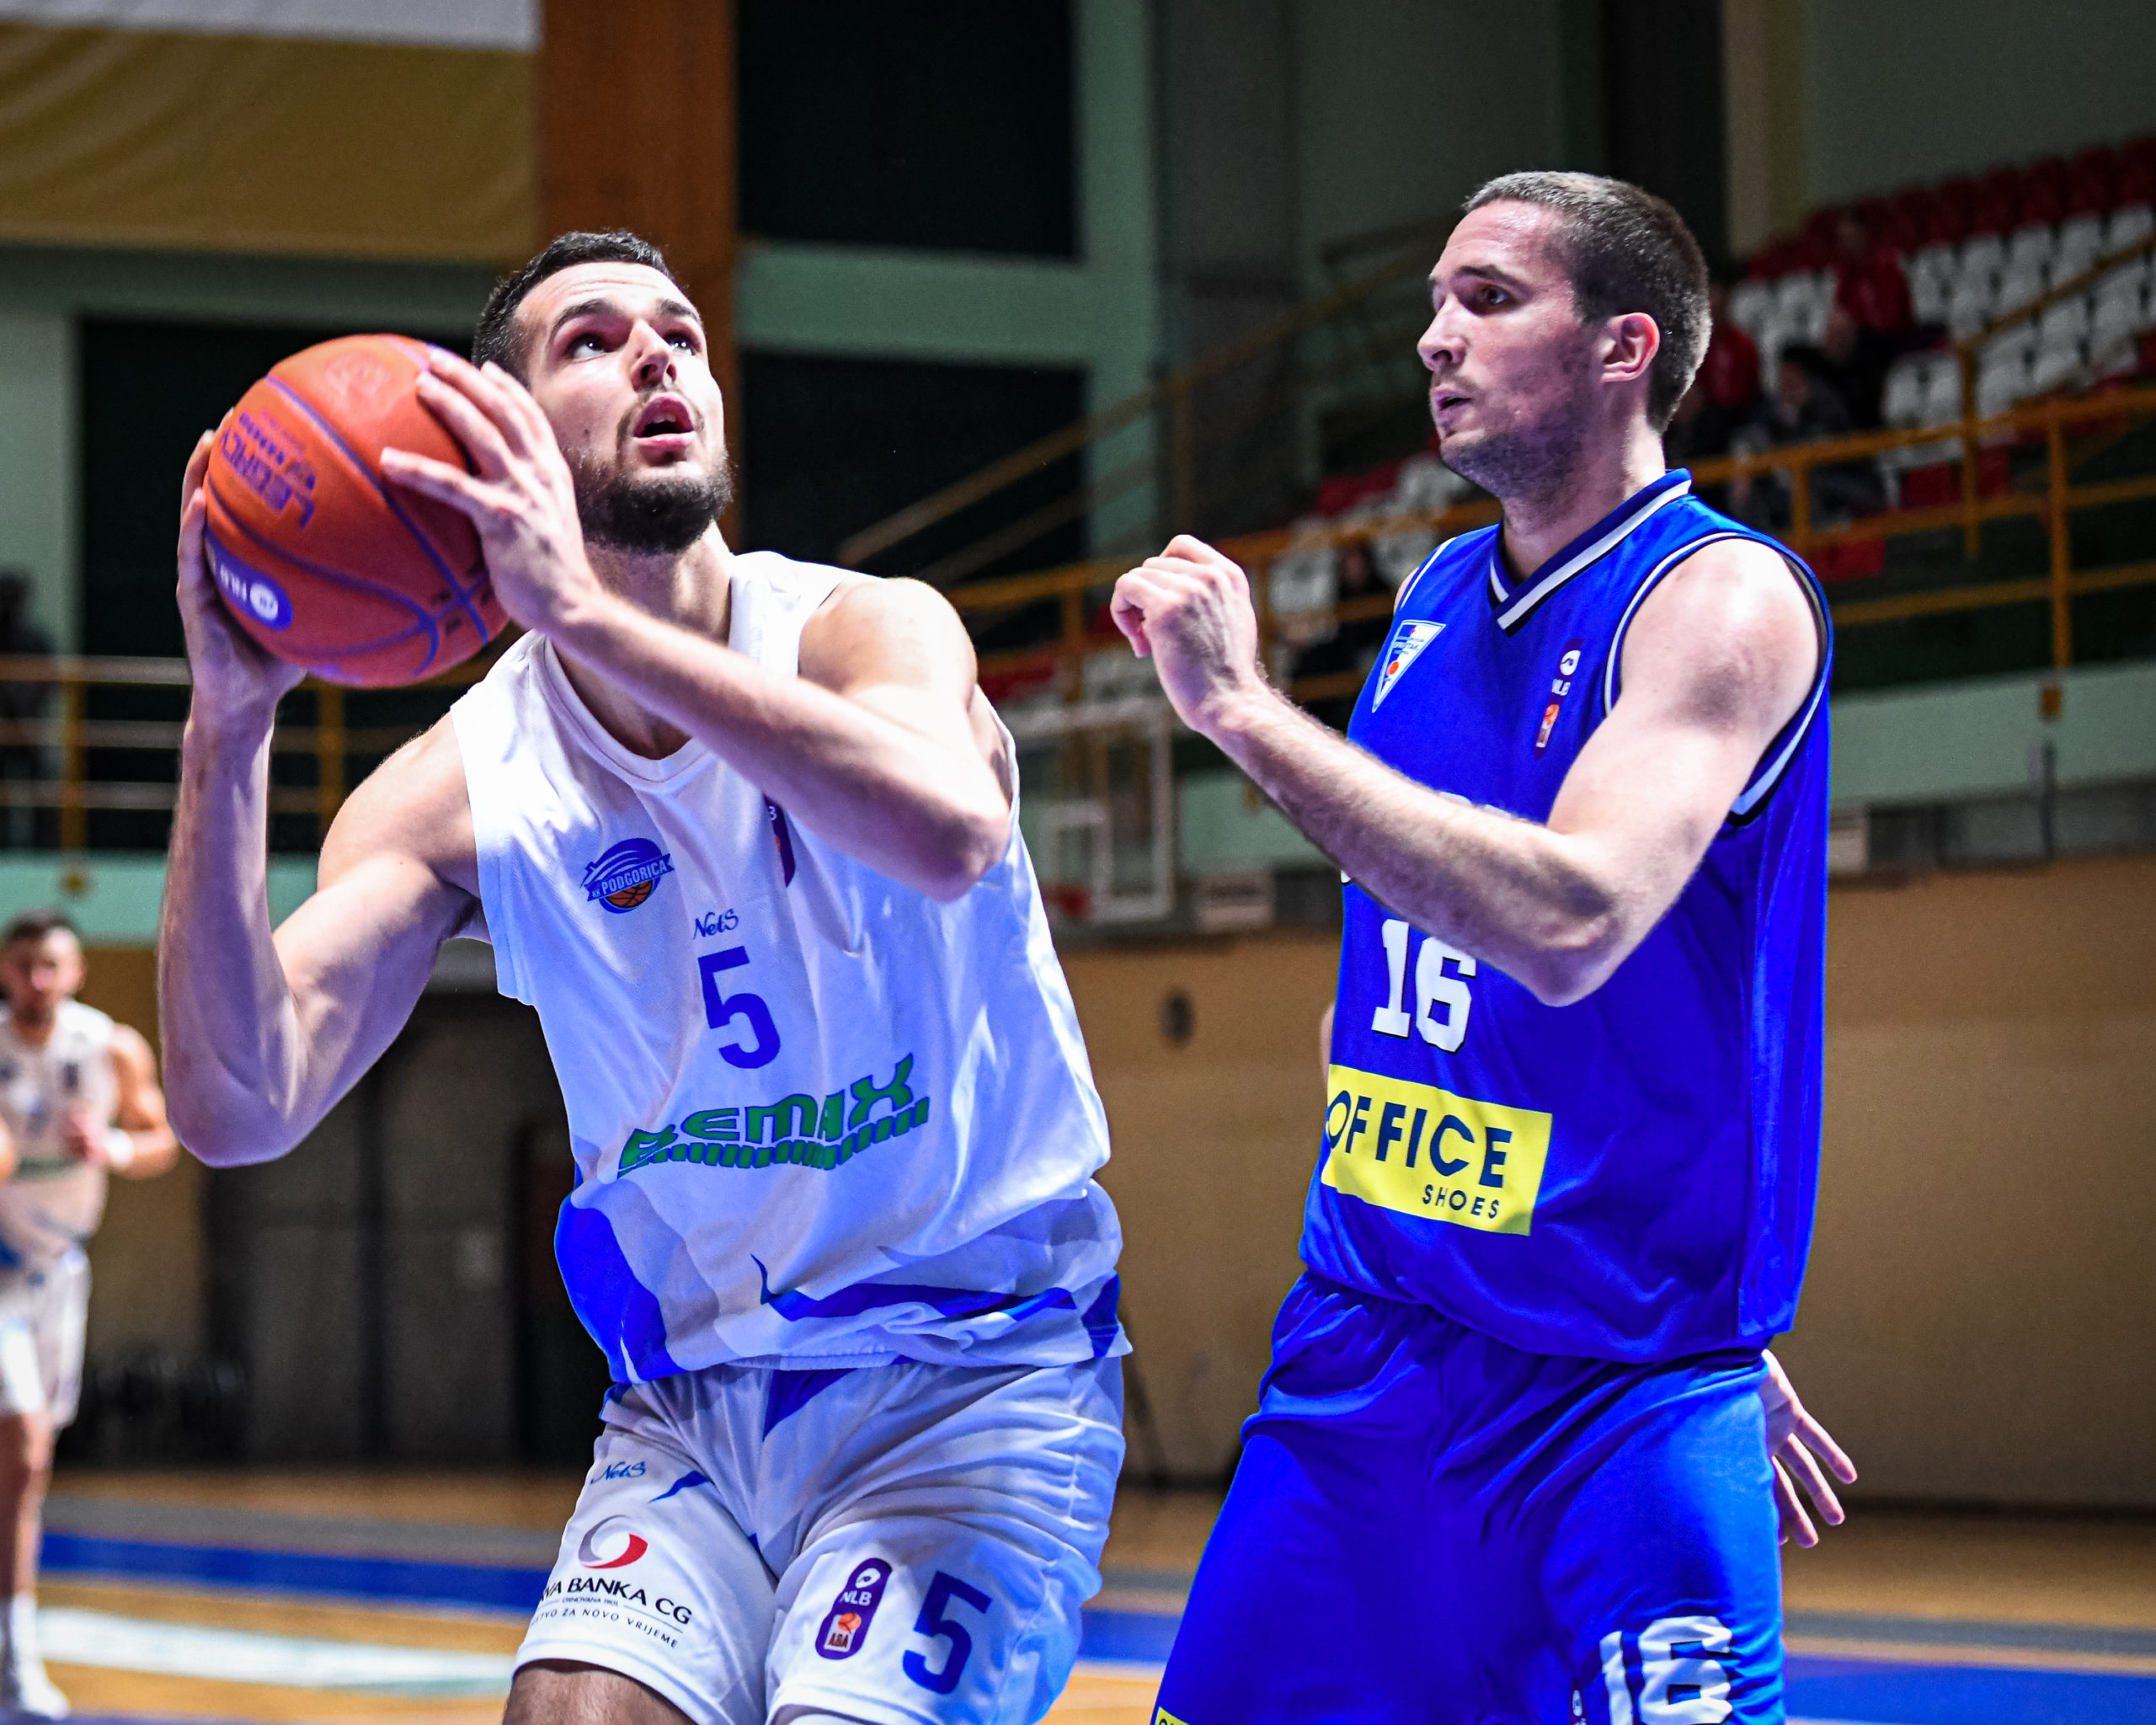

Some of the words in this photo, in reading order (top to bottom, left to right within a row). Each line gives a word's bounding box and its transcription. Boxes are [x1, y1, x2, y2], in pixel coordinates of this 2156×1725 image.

[601, 859, 668, 895] PODGORICA
[697, 945, 781, 1069] 5
[1372, 919, 1476, 1054] 16
[1326, 1090, 1513, 1188] OFFICE
[1422, 1183, 1500, 1219] SHOES
[541, 1580, 562, 1602] VA
[567, 1578, 648, 1606] BANKA
[655, 1597, 692, 1626] CG
[563, 1608, 576, 1616] ZA
[582, 1608, 619, 1621] NOVO
[627, 1617, 679, 1648] VRIJEME
[840, 1590, 872, 1606] NLB
[903, 1570, 993, 1695] 5
[1599, 1616, 1733, 1725] 16
